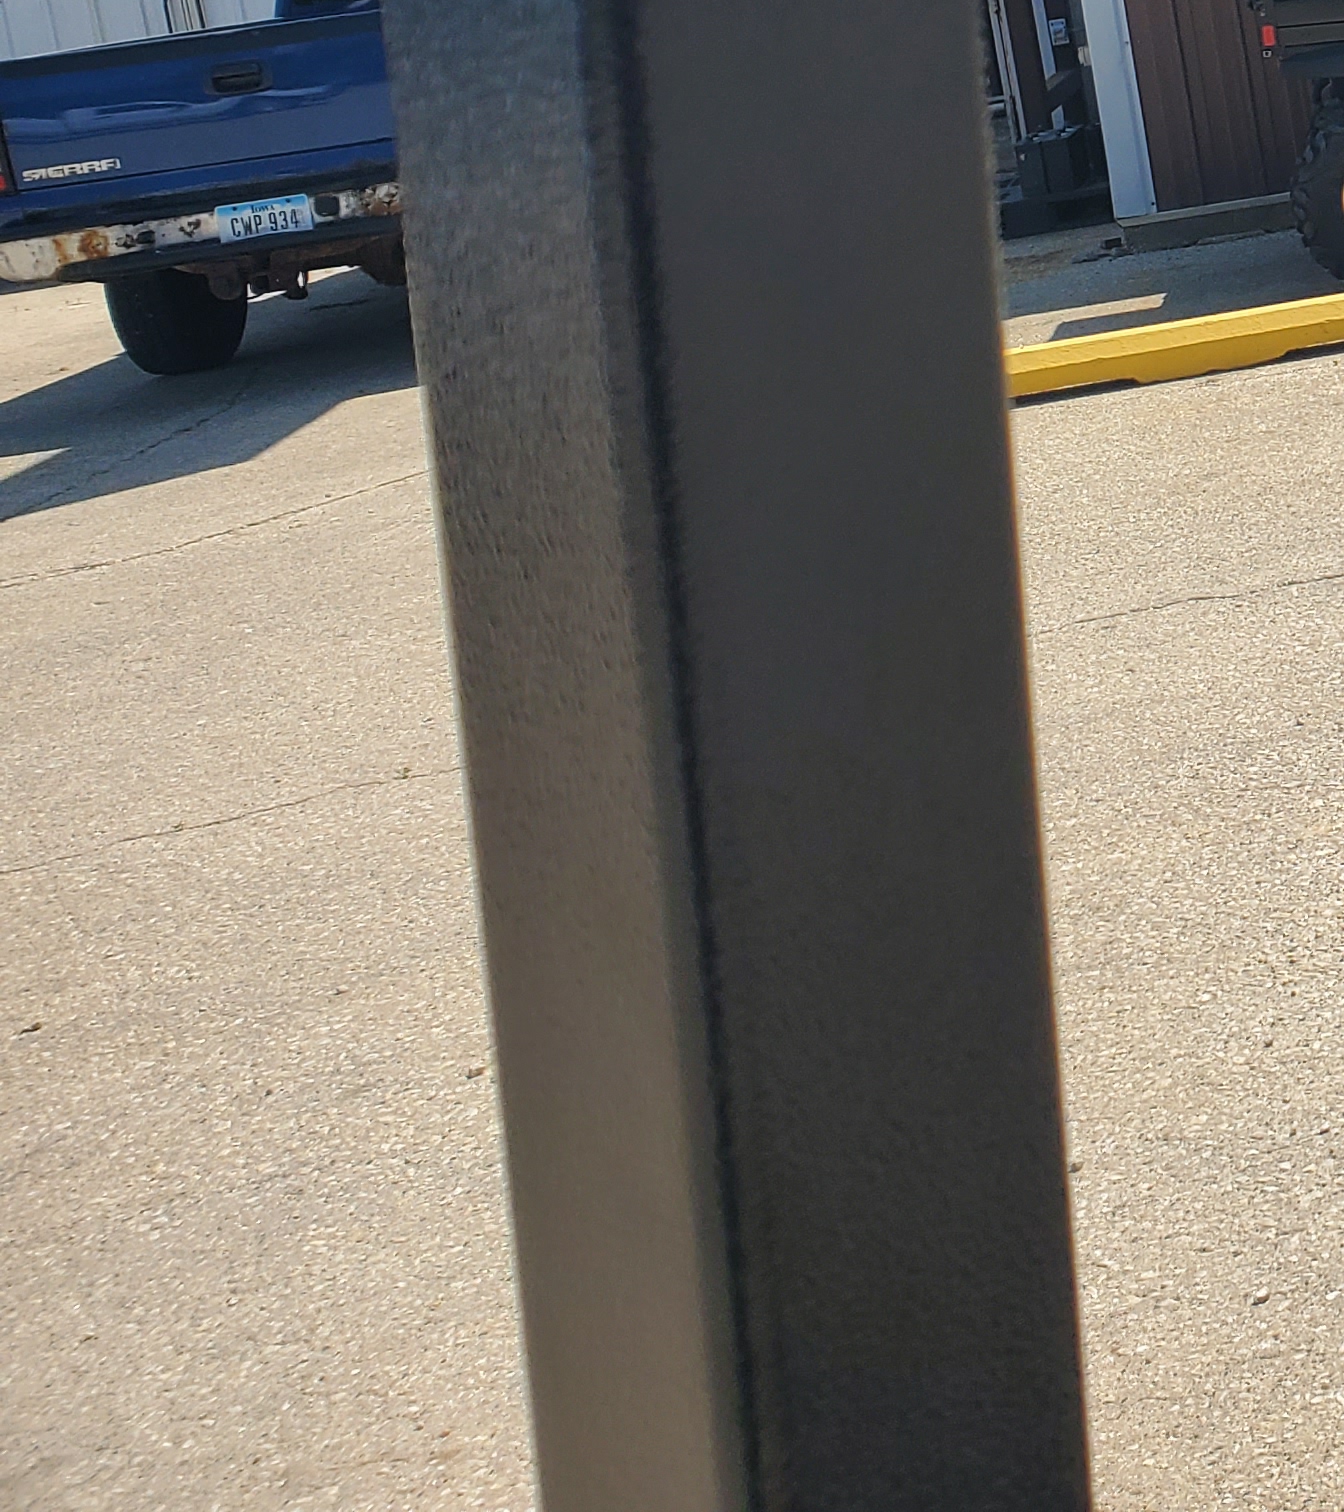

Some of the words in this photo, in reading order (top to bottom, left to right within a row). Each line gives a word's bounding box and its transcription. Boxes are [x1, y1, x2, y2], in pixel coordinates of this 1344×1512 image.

[22, 157, 121, 182] SIERRA
[230, 214, 262, 238] CWP
[268, 208, 299, 232] 934
